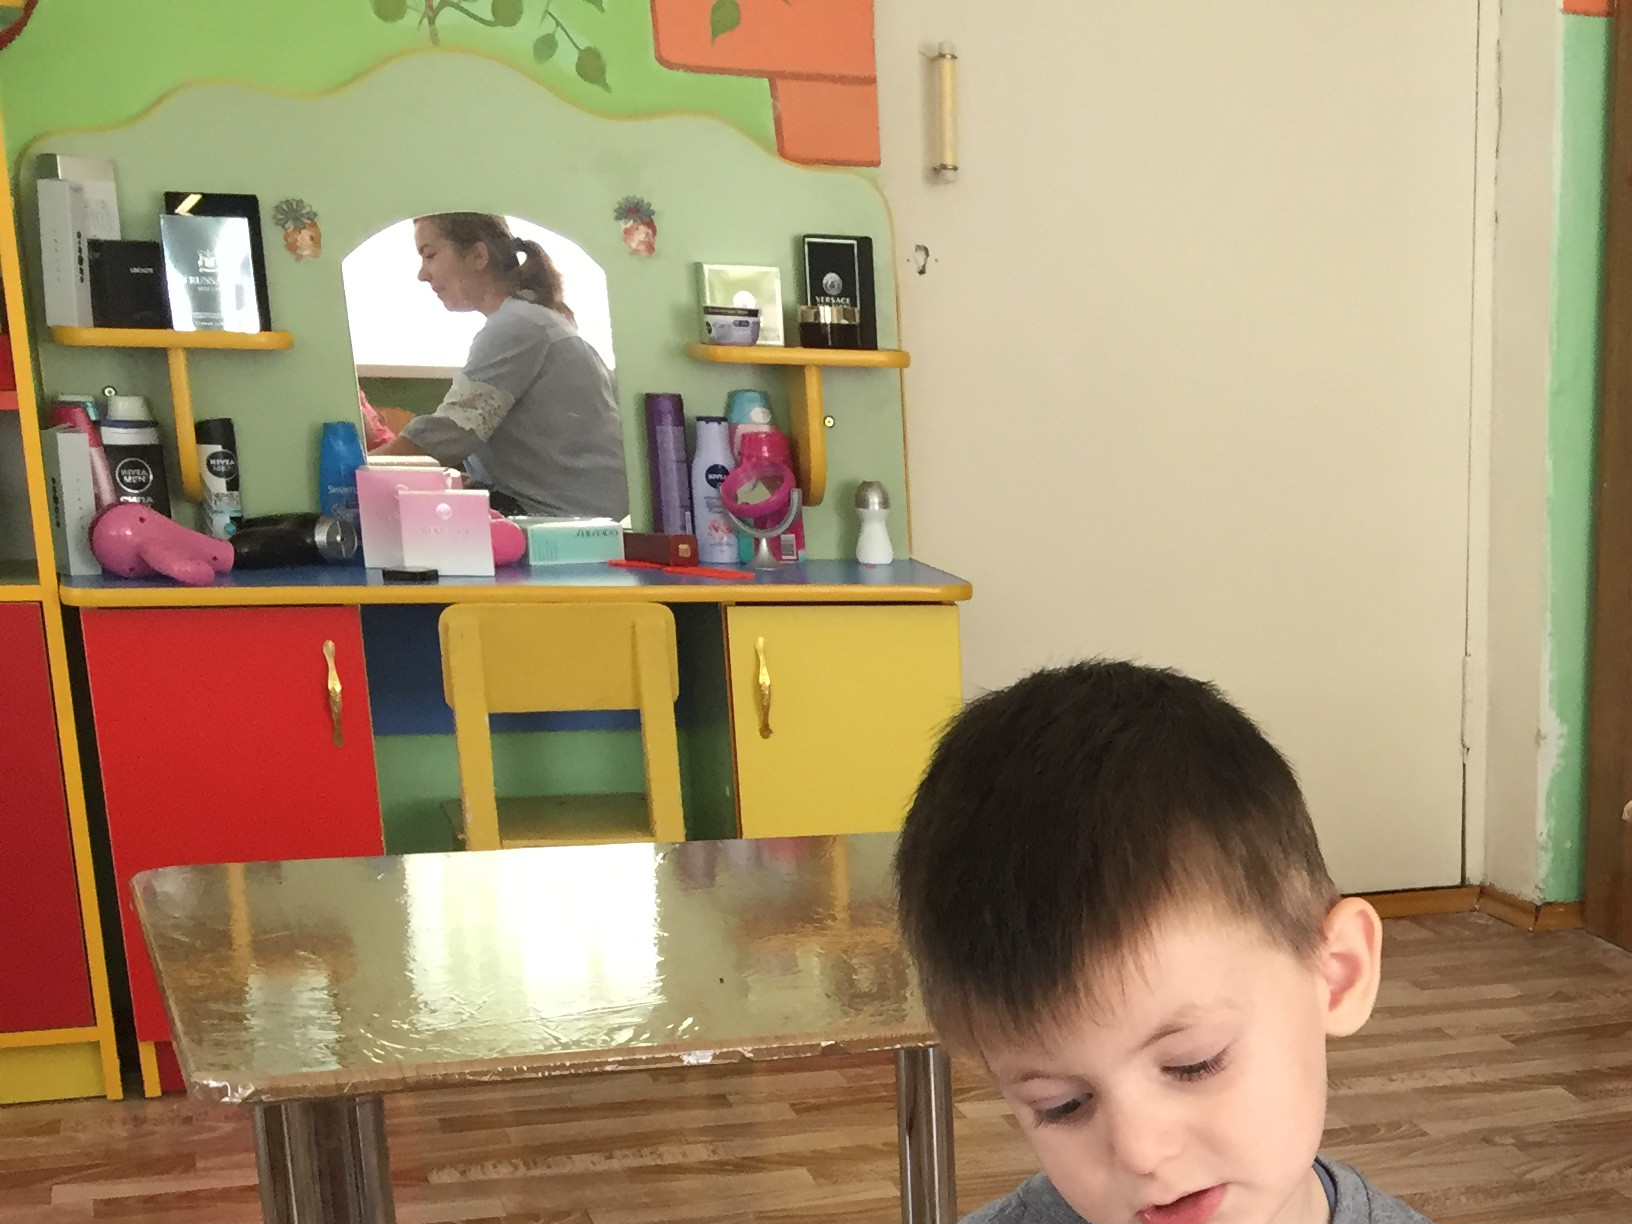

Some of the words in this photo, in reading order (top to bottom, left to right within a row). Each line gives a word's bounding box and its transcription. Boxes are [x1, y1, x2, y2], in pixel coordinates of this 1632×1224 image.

[815, 295, 850, 304] VERSACE
[209, 458, 235, 466] NIVEA
[120, 468, 148, 476] NIVEA
[123, 475, 146, 483] MEN
